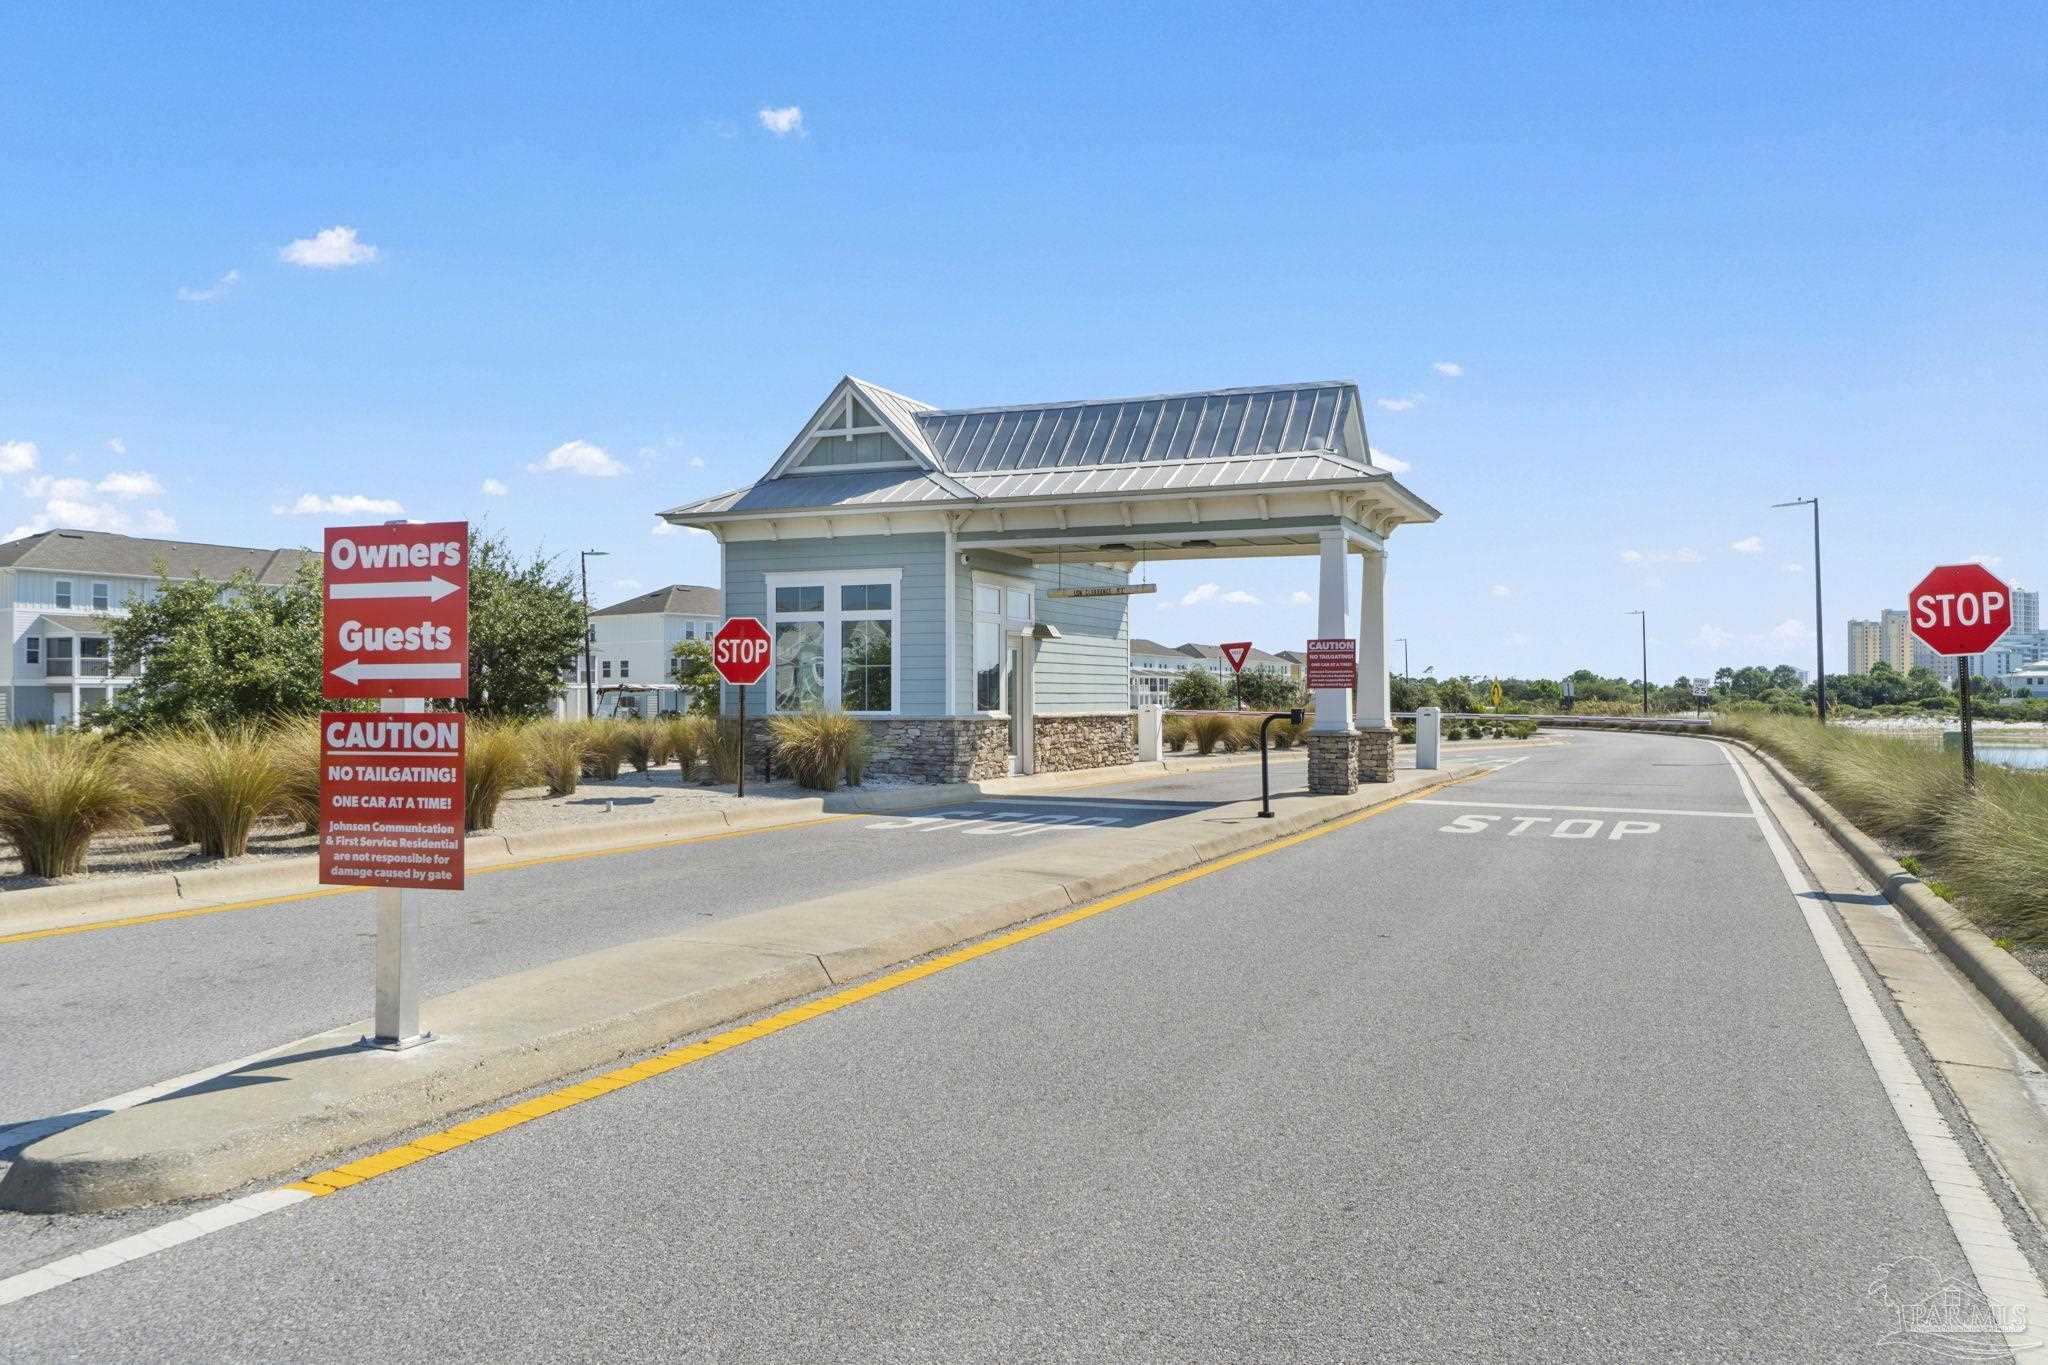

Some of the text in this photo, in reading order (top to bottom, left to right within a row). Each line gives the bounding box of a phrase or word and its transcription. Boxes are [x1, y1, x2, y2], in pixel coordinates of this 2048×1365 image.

[330, 538, 461, 570] Owners
[1916, 591, 2005, 629] STOP
[339, 620, 451, 652] Guests
[717, 638, 768, 664] STOP
[1309, 641, 1354, 650] CAUTION
[326, 721, 459, 749] CAUTION
[328, 765, 457, 783] NO TAILGATING!
[332, 795, 452, 810] ONE CAR AT A TIME!
[329, 821, 455, 834] Johnson Communication
[1438, 814, 1661, 841] STOP
[325, 836, 459, 850] & First Service Residential
[333, 852, 450, 865] are not responsible for
[331, 865, 453, 881] damage caused by gate
